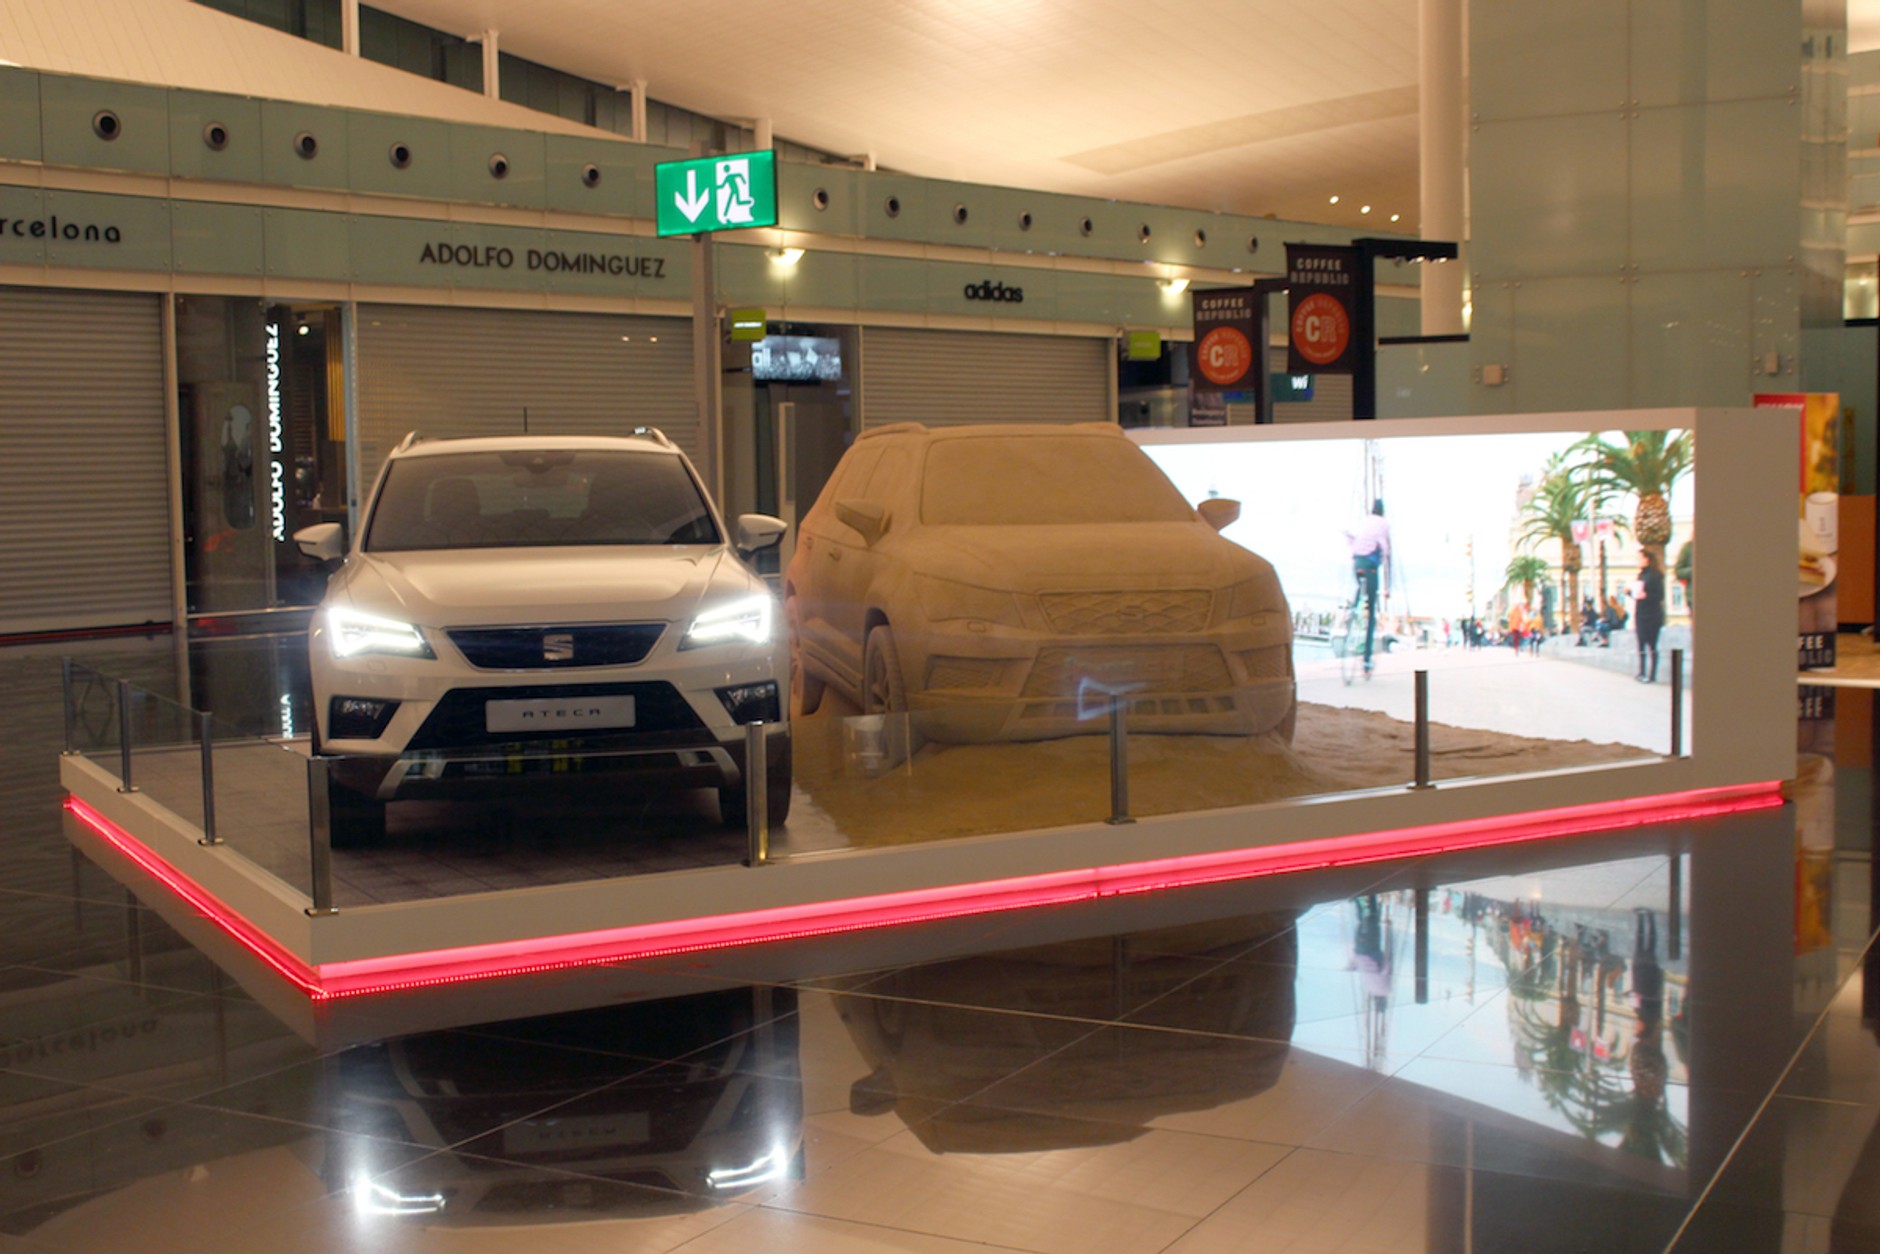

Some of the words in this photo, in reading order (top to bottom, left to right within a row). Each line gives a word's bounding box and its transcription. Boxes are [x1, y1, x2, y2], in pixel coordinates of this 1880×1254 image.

[420, 242, 514, 268] ADOLFO
[526, 249, 666, 279] DOMINGUEZ
[1296, 257, 1342, 271] COFFEE
[1290, 270, 1350, 285] REPUBLIC
[964, 280, 1024, 303] adidas
[1202, 298, 1244, 310] COFFEE
[1196, 308, 1252, 321] REPUBLIC
[265, 323, 282, 452] DOMINGUEZ
[270, 461, 285, 542] ADOLFO
[522, 708, 601, 719] ATECA
